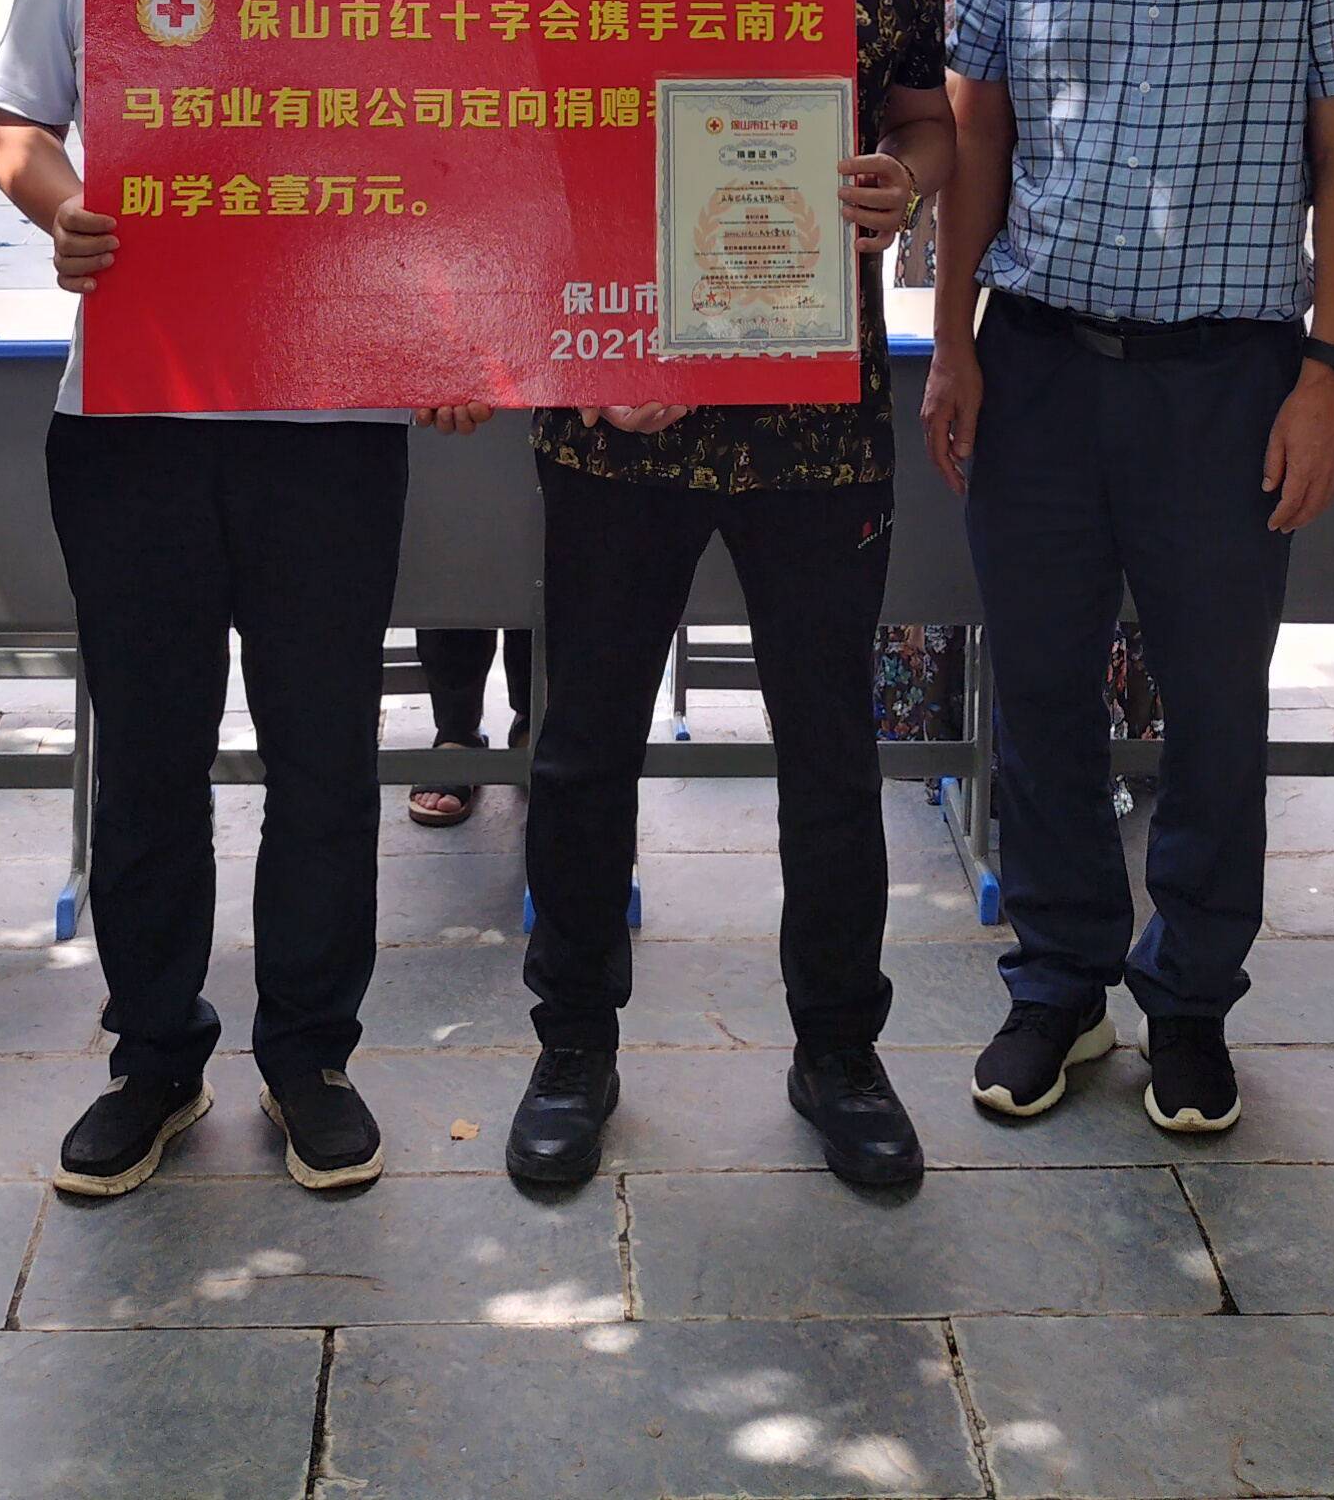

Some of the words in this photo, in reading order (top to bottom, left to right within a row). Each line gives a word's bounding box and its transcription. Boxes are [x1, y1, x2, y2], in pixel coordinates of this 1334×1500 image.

[238, 0, 825, 43] 保山市红十字会携手云南龙
[120, 174, 430, 218] 助学金壹万元。
